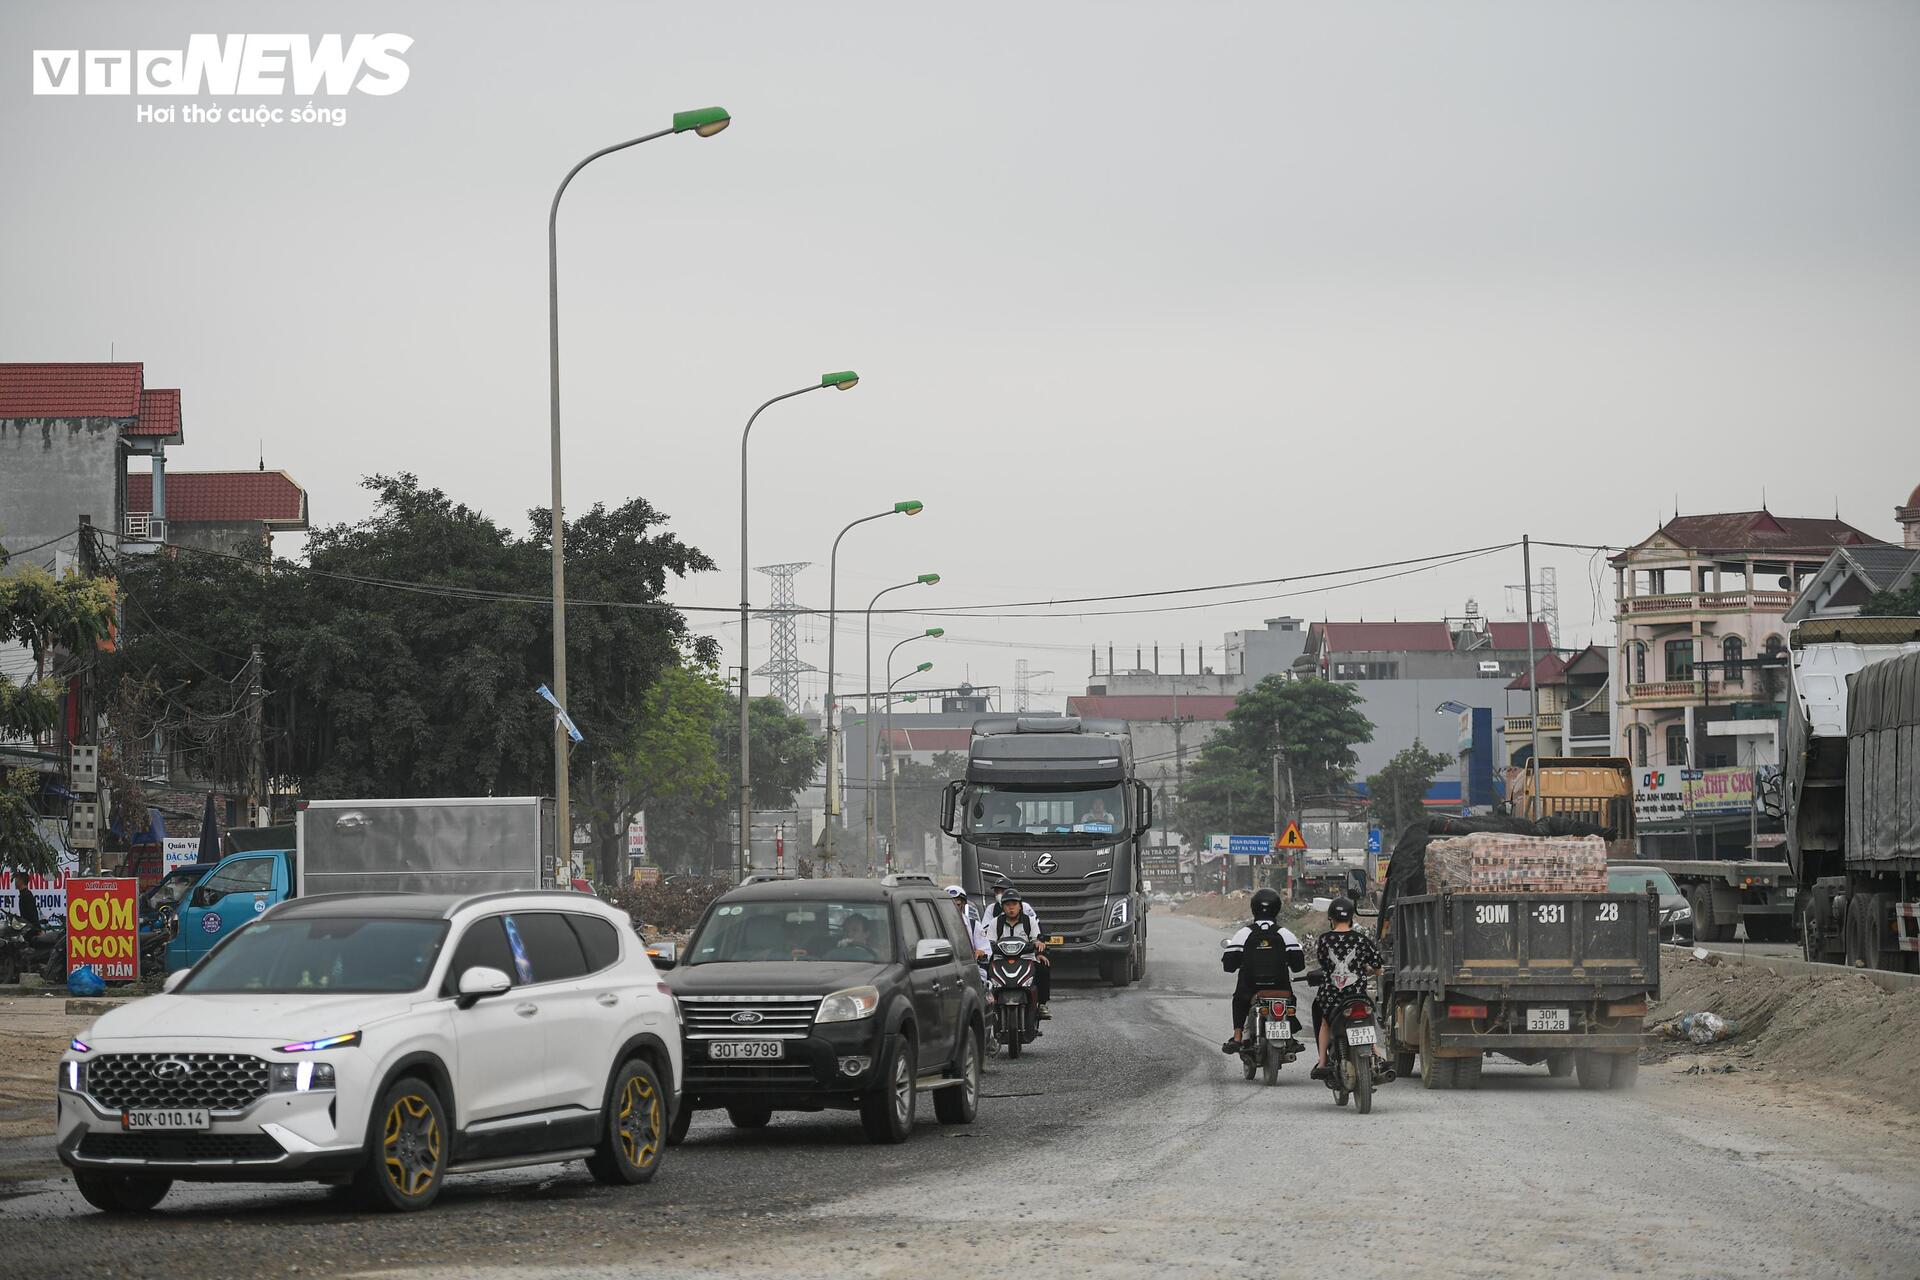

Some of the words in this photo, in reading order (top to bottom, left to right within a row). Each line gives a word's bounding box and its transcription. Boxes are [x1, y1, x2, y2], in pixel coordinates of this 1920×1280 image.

[1661, 792, 1683, 801] MOBILE
[69, 892, 134, 931] CƠM
[1475, 904, 1509, 924] 30M
[1531, 904, 1565, 924] -331
[1595, 903, 1619, 922] .28
[70, 935, 134, 958] NGON
[107, 961, 133, 977] DÂN
[1539, 1010, 1558, 1020] 30M
[1531, 1020, 1565, 1030] 331.28
[129, 1112, 203, 1126] 30K-010.14
